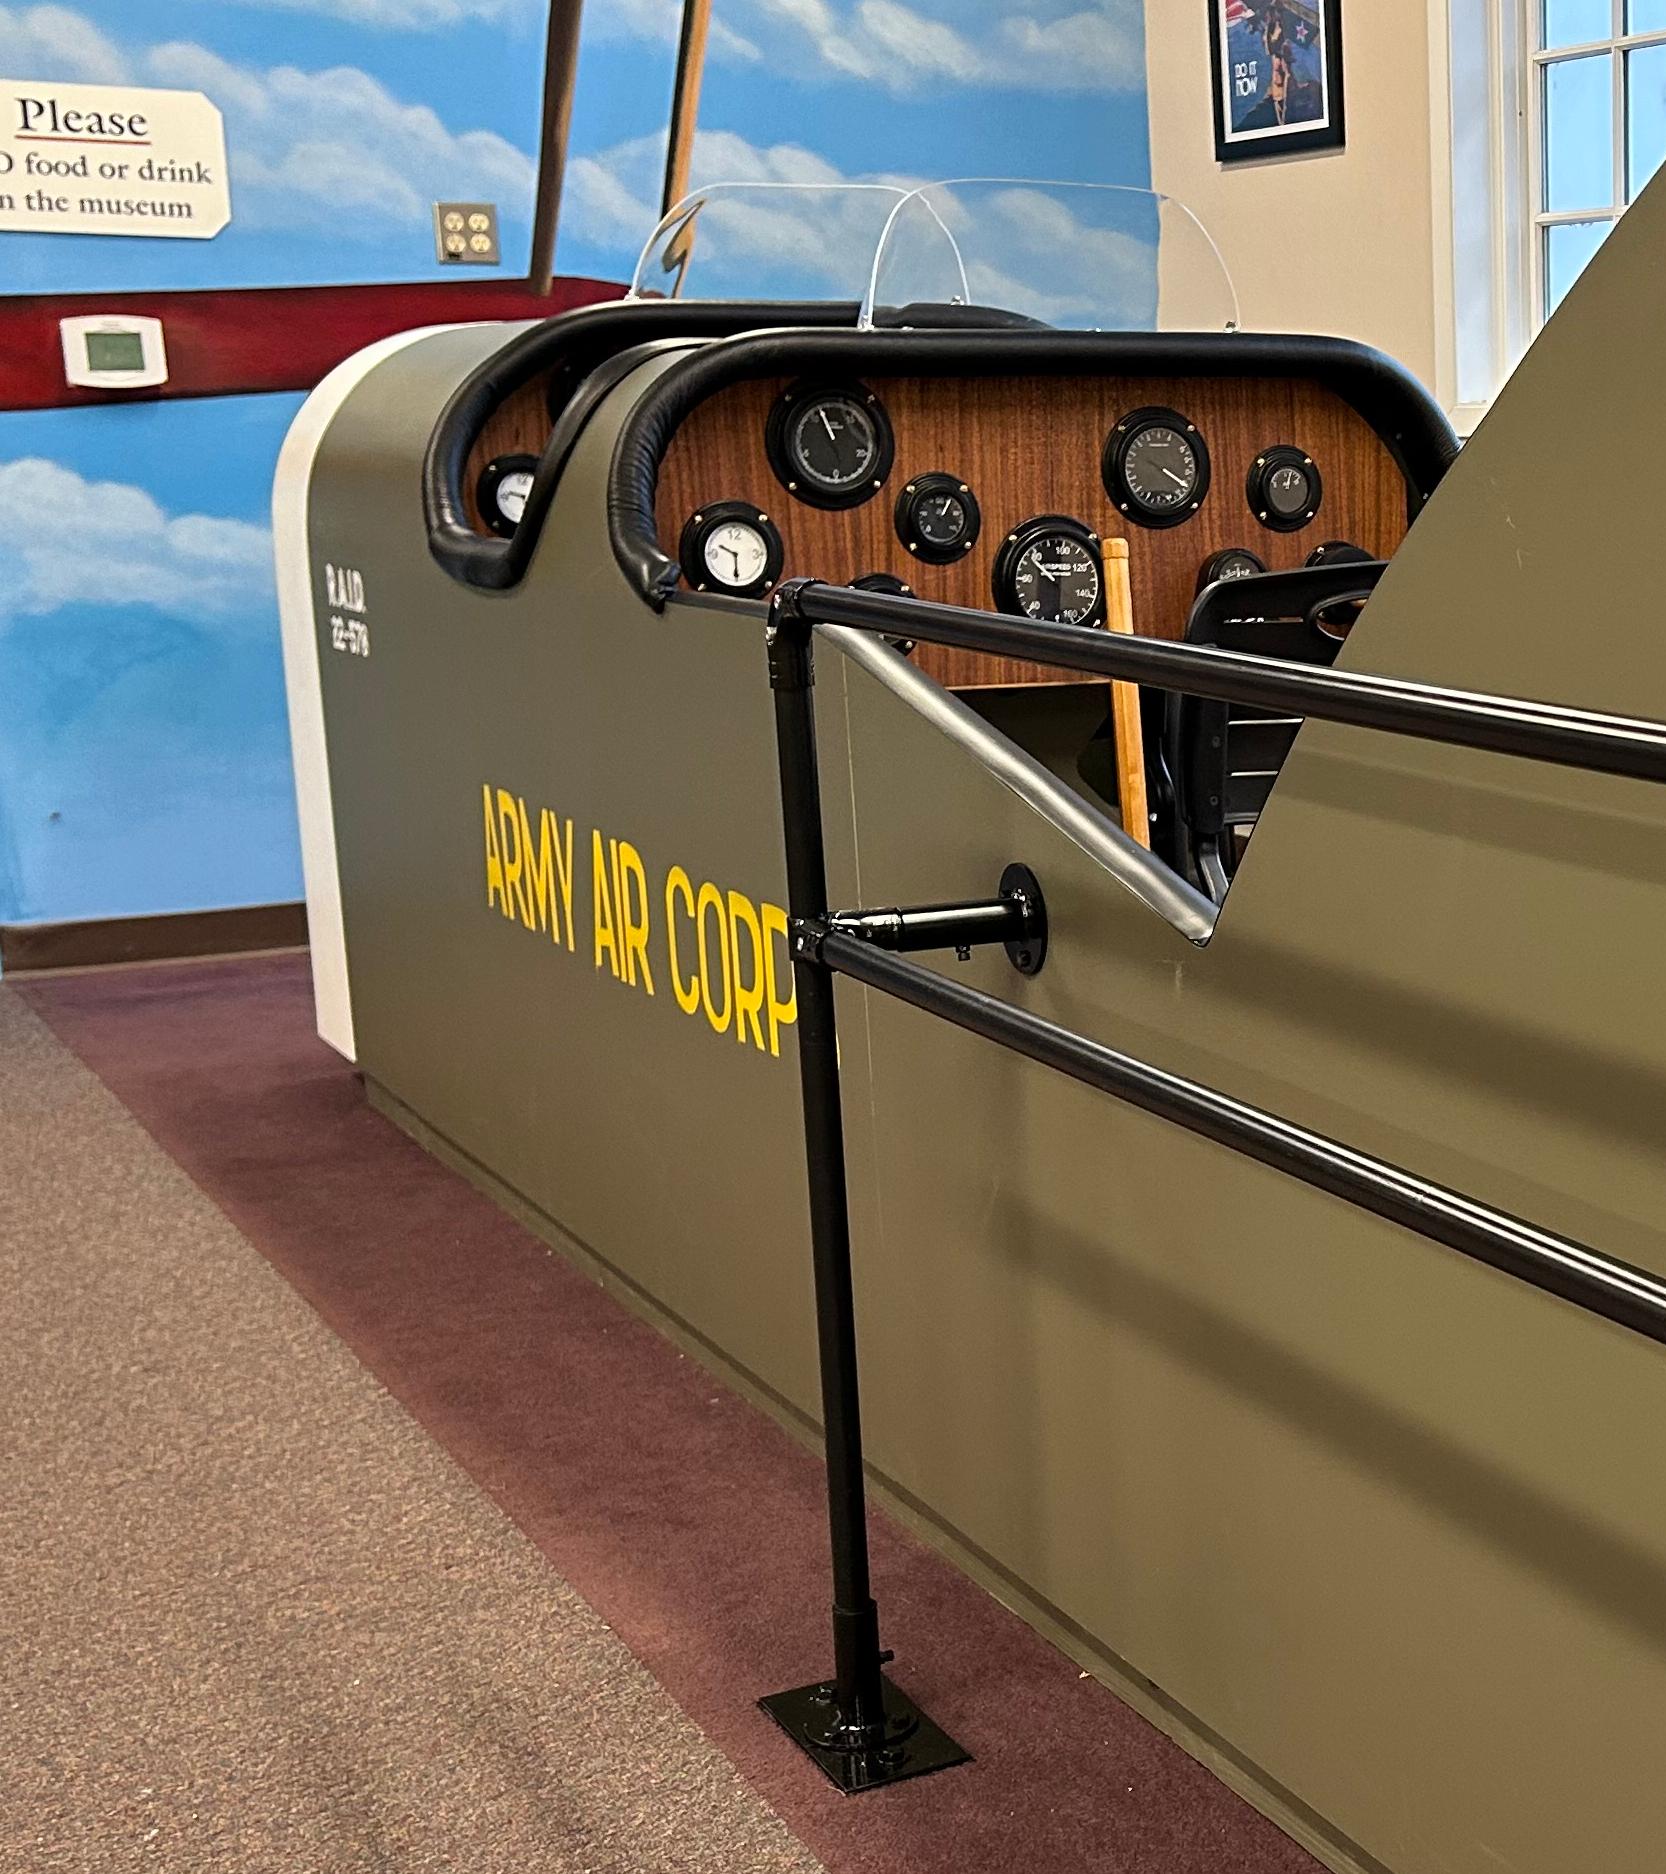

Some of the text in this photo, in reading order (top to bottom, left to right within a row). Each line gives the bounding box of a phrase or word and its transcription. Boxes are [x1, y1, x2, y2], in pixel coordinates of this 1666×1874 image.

[14, 97, 149, 137] Please
[25, 152, 89, 178] food
[98, 163, 130, 180] or
[138, 159, 214, 185] drink
[0, 189, 194, 219] n the museum
[728, 529, 742, 541] 12
[1072, 563, 1088, 573] 120
[482, 784, 840, 1070] ARMY AIR CORP
